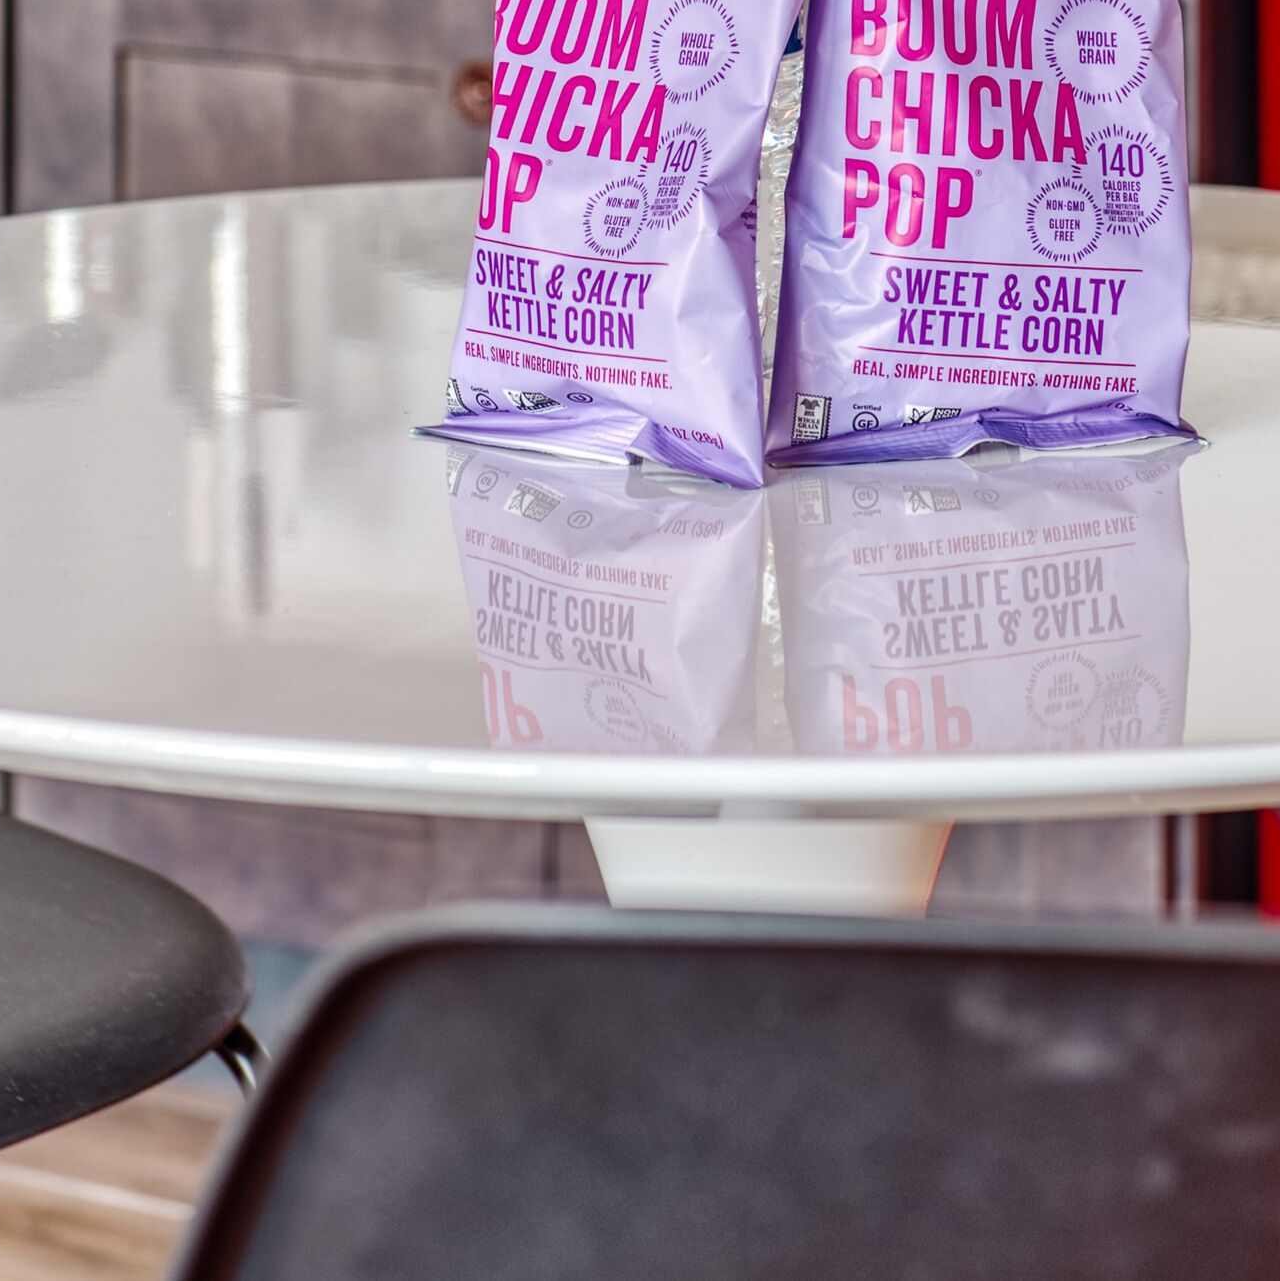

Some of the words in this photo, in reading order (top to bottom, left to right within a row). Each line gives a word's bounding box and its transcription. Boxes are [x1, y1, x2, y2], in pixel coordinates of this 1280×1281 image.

[680, 32, 715, 50] WHOLE
[1076, 30, 1118, 48] WHOLE
[678, 50, 710, 67] GRAIN
[1078, 48, 1116, 65] GRAIN
[492, 61, 667, 164] HICKA
[845, 65, 1088, 165] CHICKA
[662, 139, 698, 173] 140
[1098, 142, 1144, 178] 140
[658, 176, 686, 186] CALORIES
[1102, 180, 1141, 192] CALORIES
[479, 146, 543, 234] OP
[656, 187, 669, 197] PER
[669, 187, 680, 197] BAG
[1106, 192, 1120, 202] PER
[1122, 192, 1138, 203] BAG
[606, 197, 640, 210] NON-GMO
[842, 158, 974, 250] POP
[1046, 200, 1085, 212] NON-GMO
[604, 214, 632, 227] GLUTEN
[1049, 218, 1080, 230] GLUTEN
[605, 226, 624, 238] FREE
[1054, 230, 1074, 242] FREE
[476, 248, 540, 296] SWEET
[546, 264, 565, 300] &
[572, 267, 652, 310] SALTY
[884, 265, 989, 308] SWEET
[998, 273, 1022, 311] &
[1033, 275, 1126, 316] SALTY
[488, 291, 558, 340] KETTLE
[565, 306, 635, 350] CORN
[897, 308, 1012, 350] KETTLE
[1022, 316, 1104, 356] CORN
[465, 341, 489, 362] REAL,
[491, 346, 520, 368] SIMPLE
[522, 353, 582, 380] INGREDIENTS.
[586, 365, 636, 386] NOTHING
[640, 371, 673, 390] FAKE.
[852, 360, 890, 379] REAL,
[894, 363, 944, 382] SIMPLE
[948, 367, 1038, 388] INGREDIENTS.
[1043, 374, 1102, 392] NOTHING
[1105, 376, 1140, 394] FAKE.
[852, 403, 882, 412] Certified
[936, 408, 959, 416] NON
[798, 416, 820, 424] WHOLE
[798, 422, 818, 430] GRAIN
[858, 419, 873, 429] GF
[673, 428, 690, 442] OZ
[692, 429, 724, 451] (28g)
